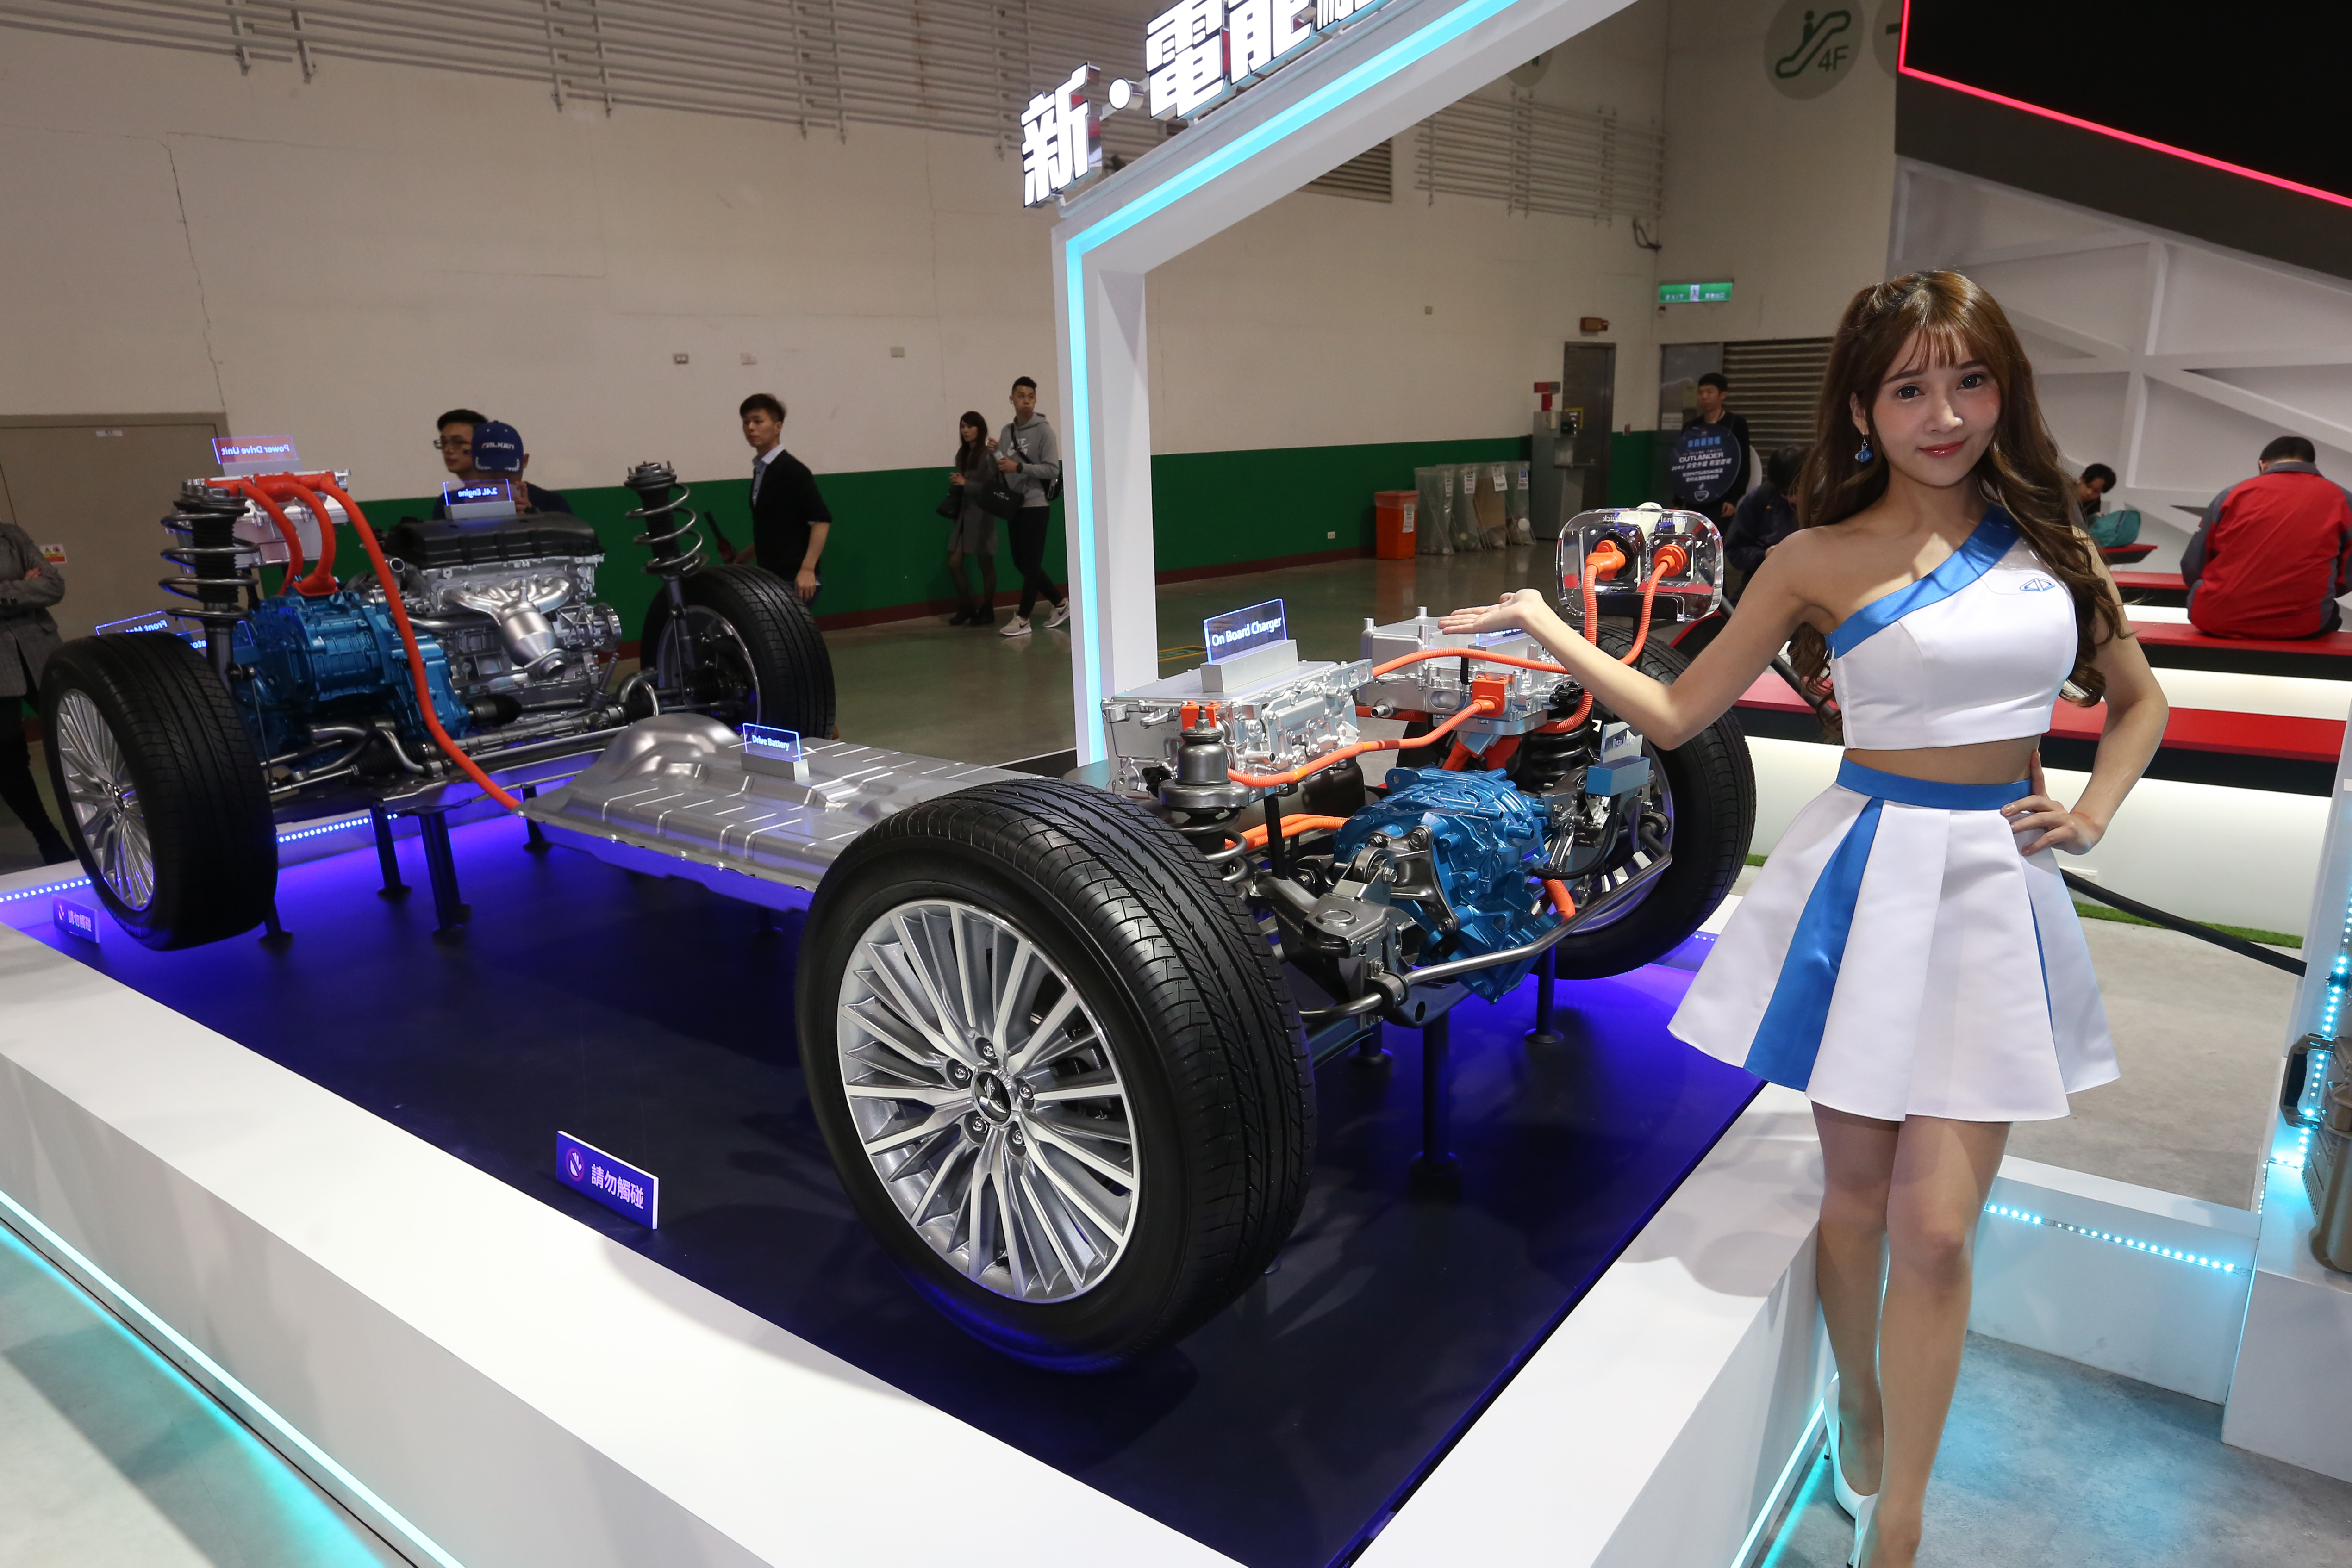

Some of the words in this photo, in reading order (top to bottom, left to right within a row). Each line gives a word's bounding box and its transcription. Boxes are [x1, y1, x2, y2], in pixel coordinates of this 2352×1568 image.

[1818, 45, 1849, 72] 4F
[1679, 452, 1724, 463] OUTLANDER
[1211, 634, 1226, 647] On
[1226, 623, 1251, 642] Board
[1251, 617, 1282, 633] Charger
[752, 734, 767, 746] Drive
[767, 738, 790, 752] Battery
[591, 1163, 644, 1210] 請勿觸碰
